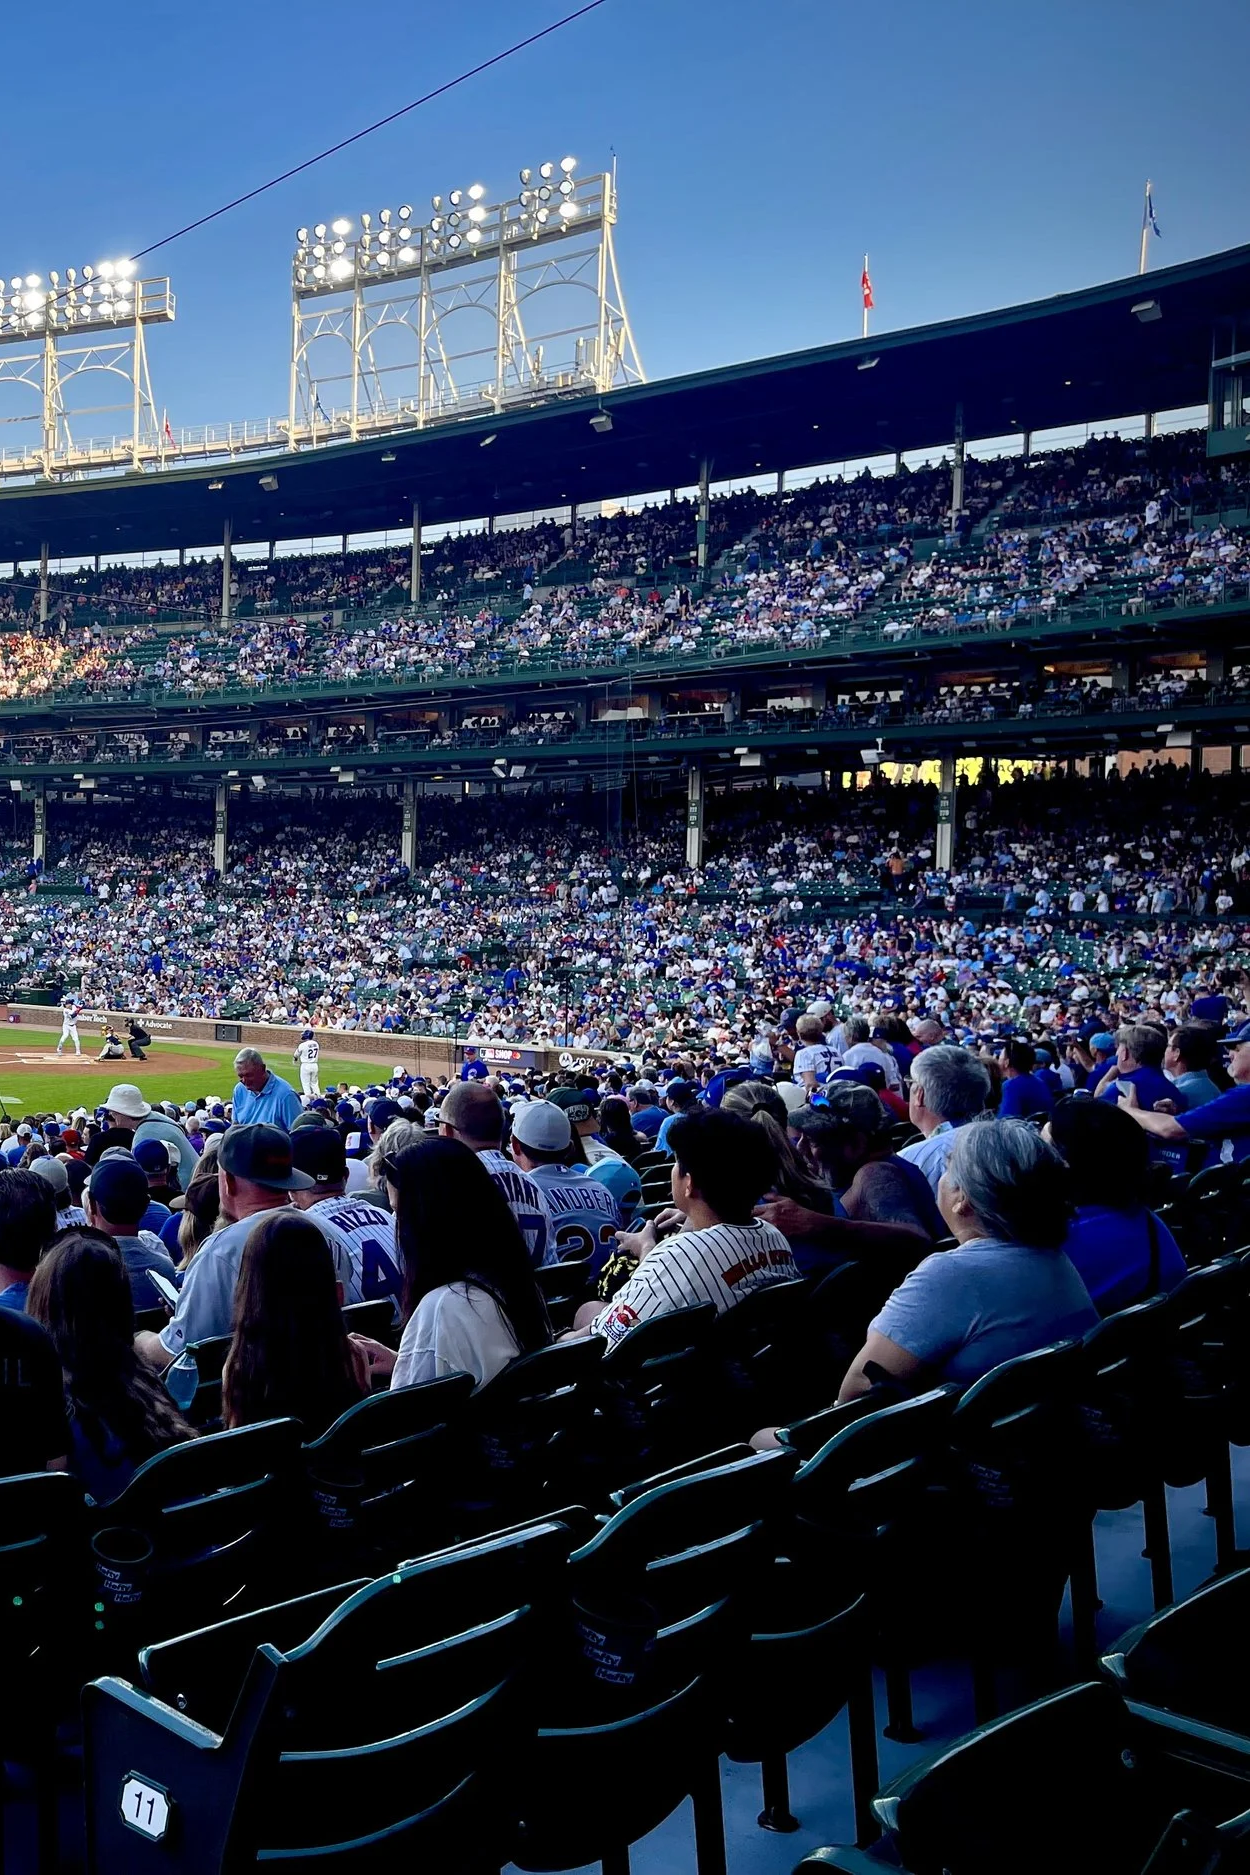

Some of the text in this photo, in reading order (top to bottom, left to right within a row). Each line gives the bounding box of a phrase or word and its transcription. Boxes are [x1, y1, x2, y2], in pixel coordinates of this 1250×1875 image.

[145, 1021, 173, 1030] Advocate
[307, 1048, 319, 1059] 27
[495, 1049, 512, 1060] SHOP
[327, 1208, 389, 1235] RIZZO
[134, 1790, 155, 1826] 11
